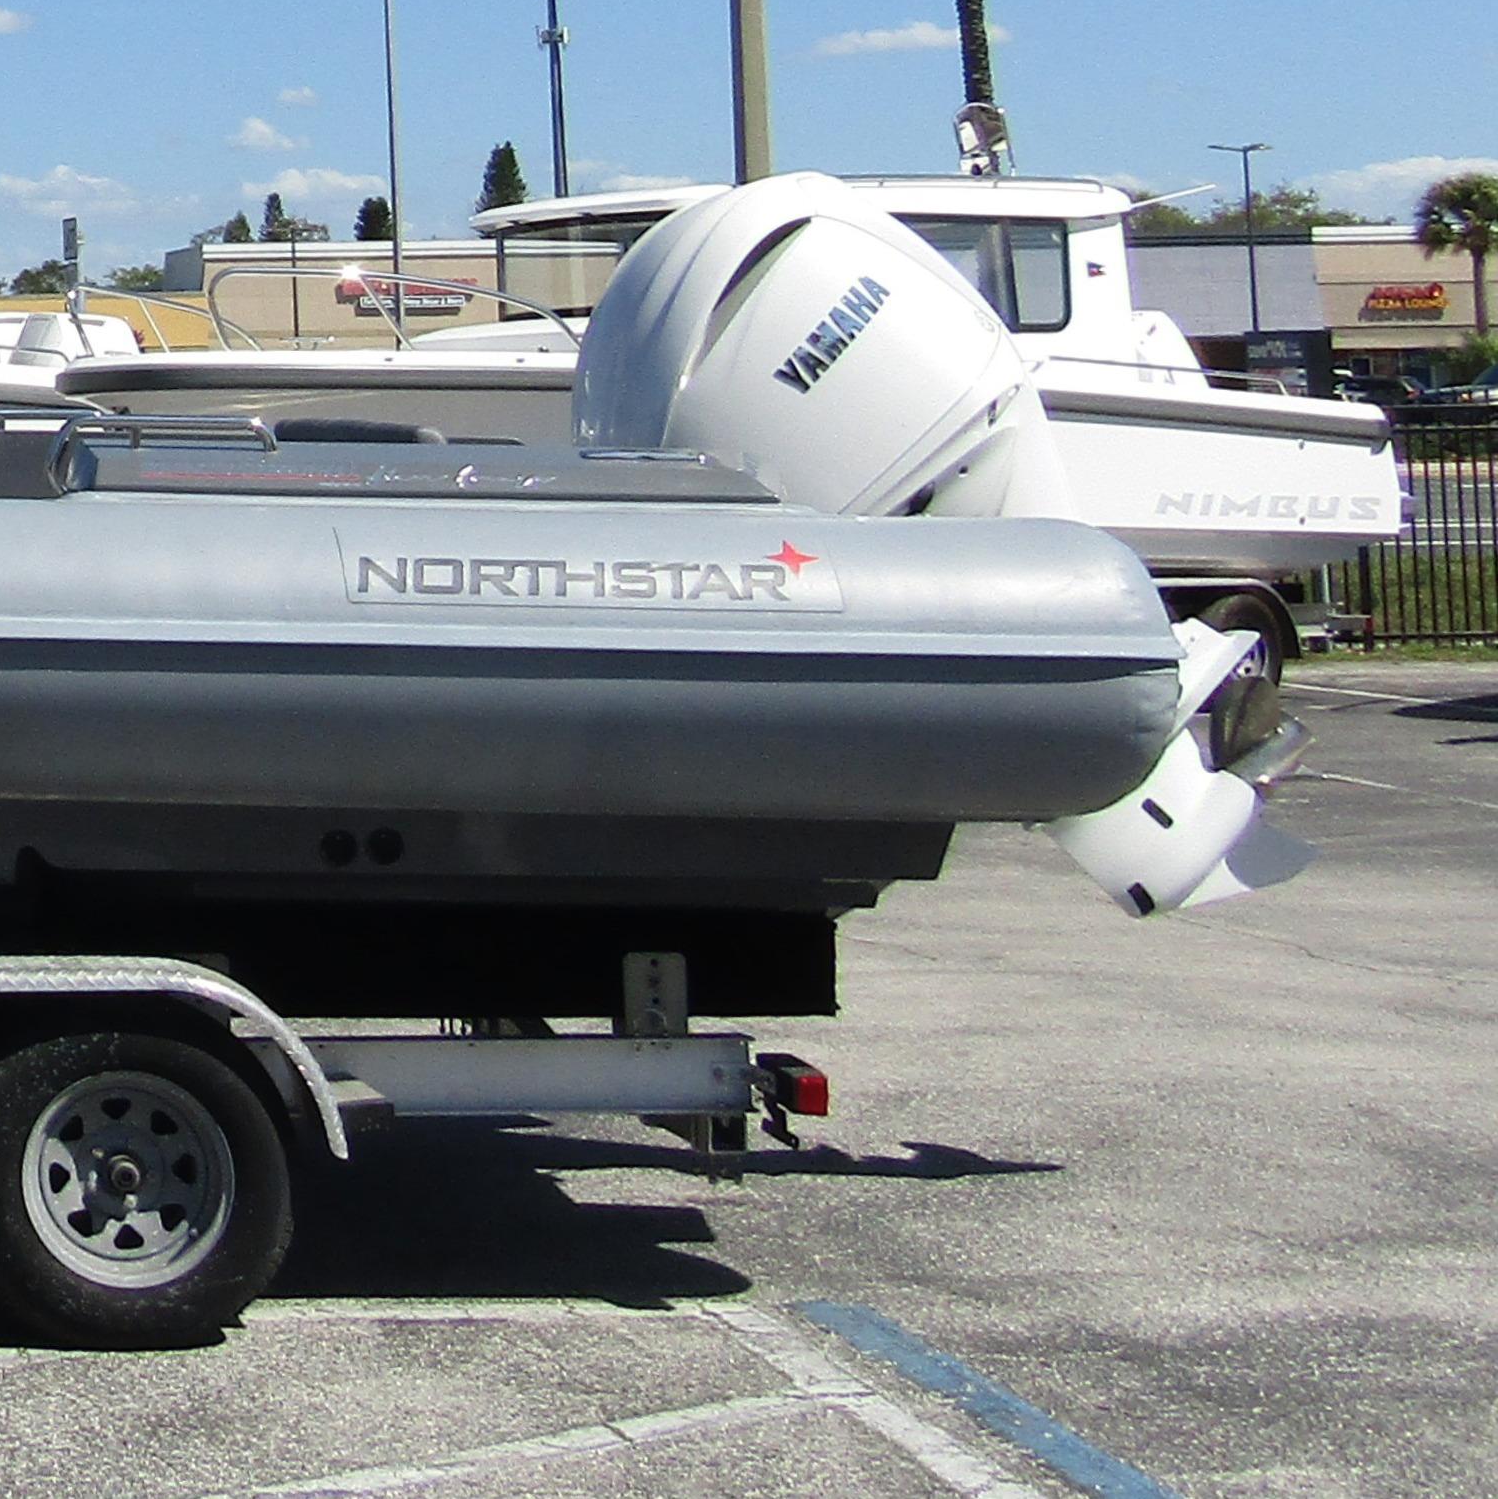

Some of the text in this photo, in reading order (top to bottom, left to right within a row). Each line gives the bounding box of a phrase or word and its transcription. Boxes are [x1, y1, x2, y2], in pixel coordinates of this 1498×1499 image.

[772, 276, 891, 394] YAMAHA
[1155, 492, 1381, 520] NIMBUS
[357, 556, 791, 601] NORTHSTAR
